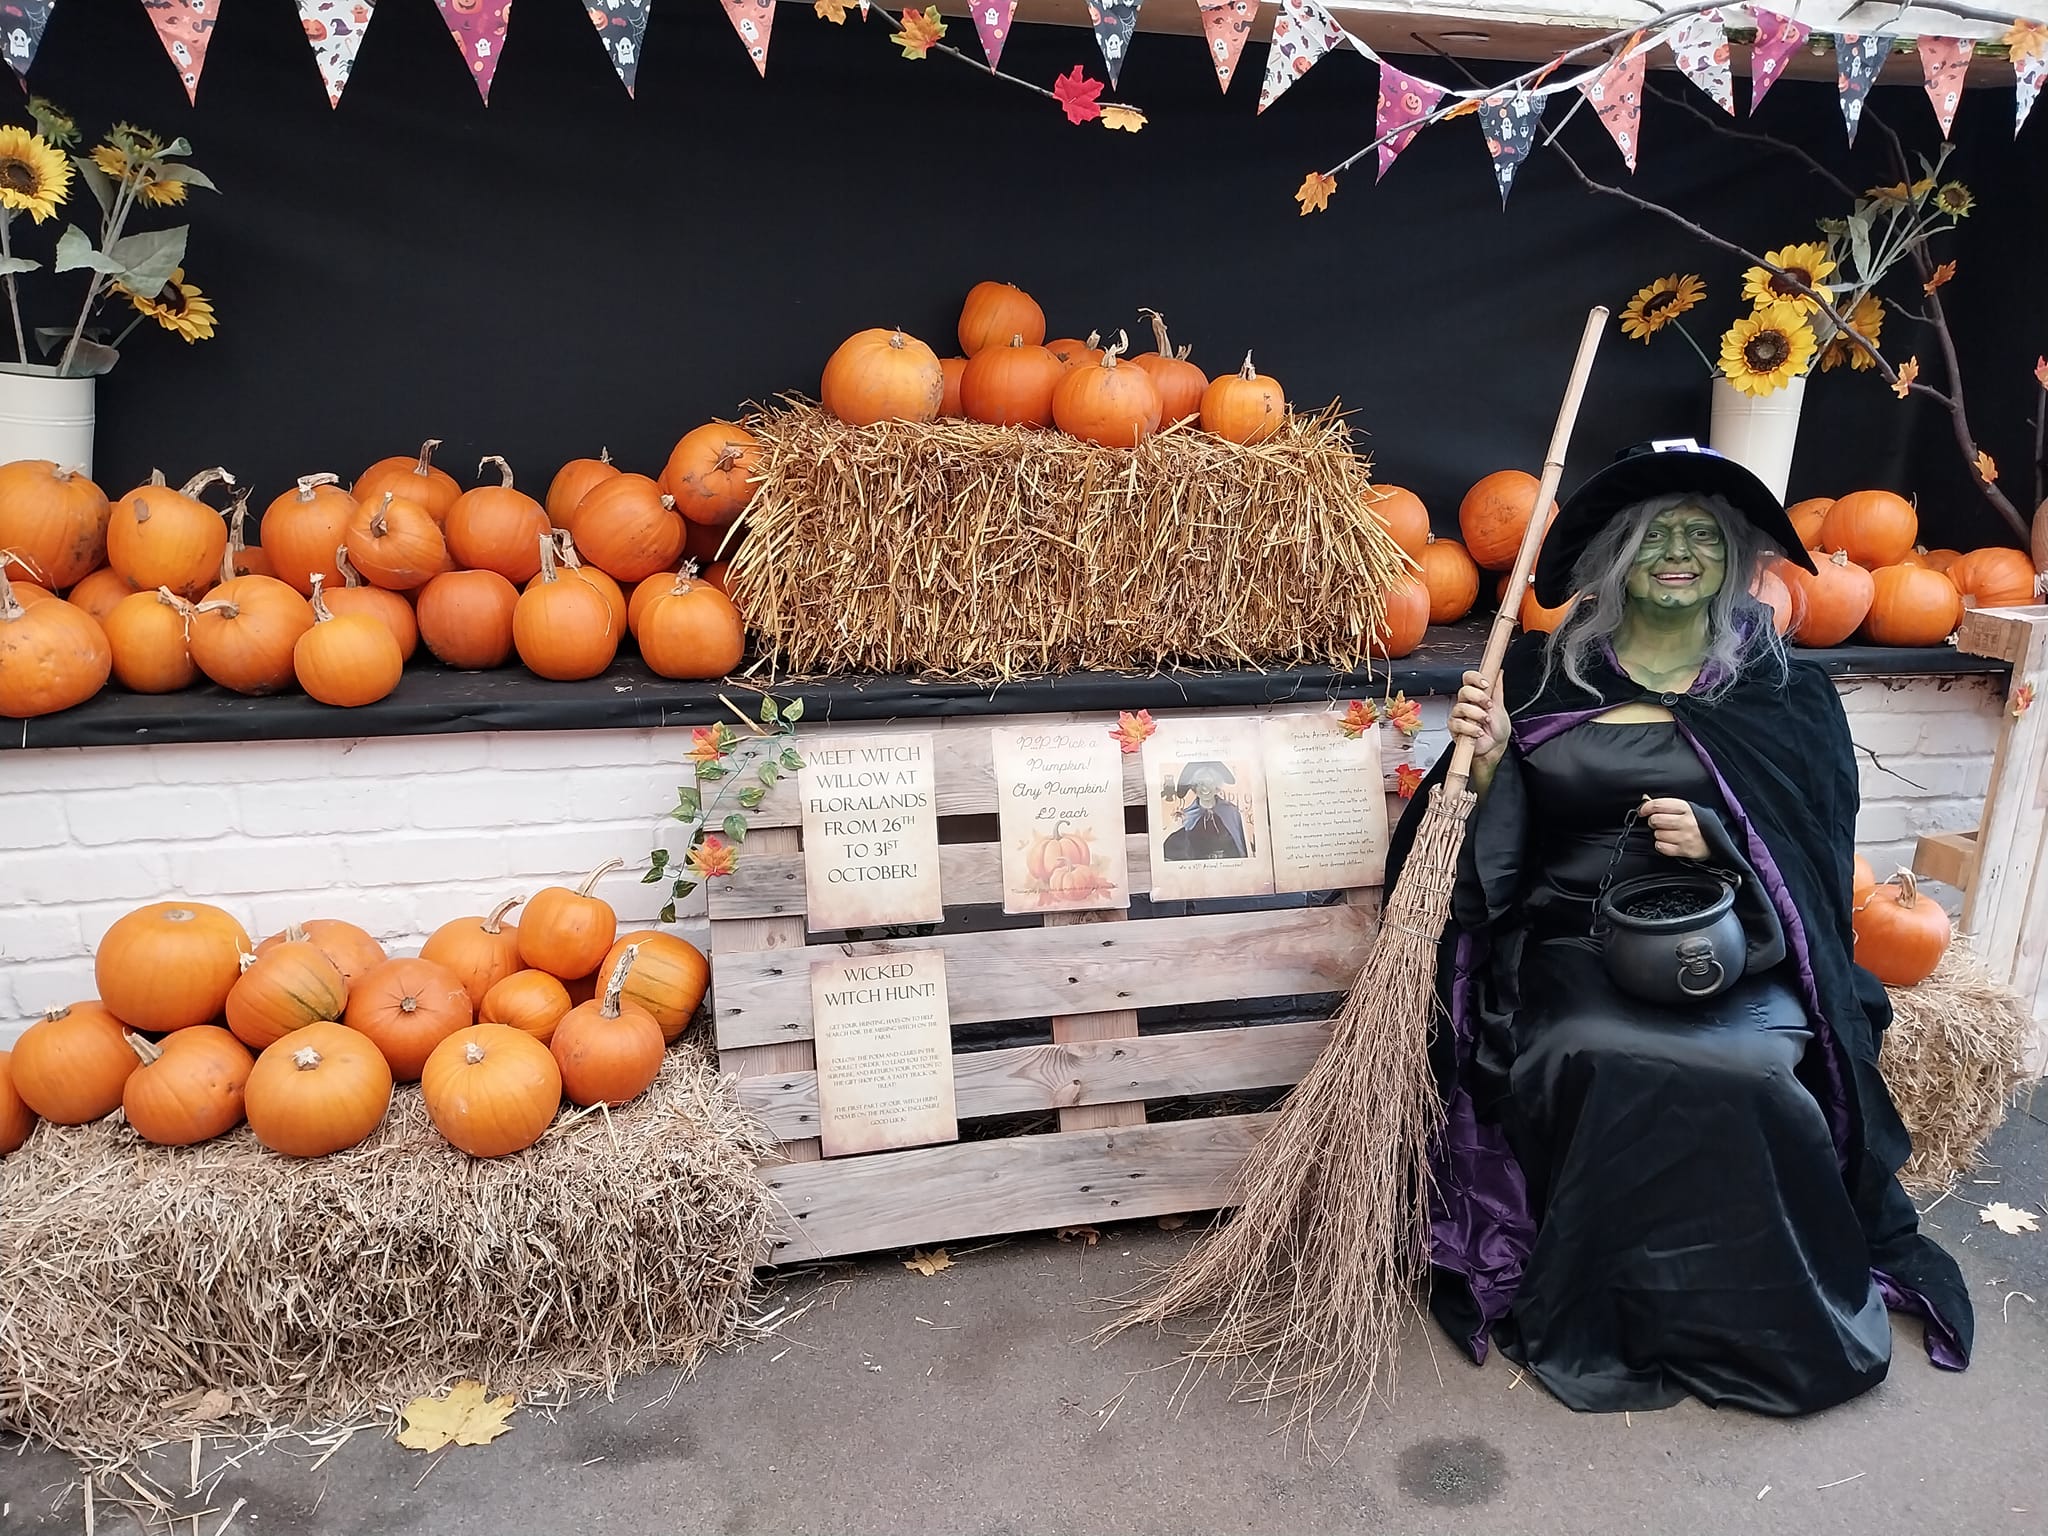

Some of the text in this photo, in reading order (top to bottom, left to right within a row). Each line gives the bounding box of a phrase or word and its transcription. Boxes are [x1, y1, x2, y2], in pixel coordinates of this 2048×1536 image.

[809, 747, 921, 766] MEET WITCH
[1026, 756, 1091, 774] Pumpkin!
[816, 771, 917, 788] WILLOW AT
[1012, 780, 1109, 800] Any Pumpkin!
[810, 793, 927, 813] FLORALANDS
[1035, 807, 1088, 819] £2 each
[824, 815, 915, 836] FROM 26TH
[843, 840, 899, 858] TO 31ST
[828, 864, 918, 883] OCTOBER!
[844, 964, 914, 982] WICKED
[824, 983, 936, 1006] WITCH HUNT!
